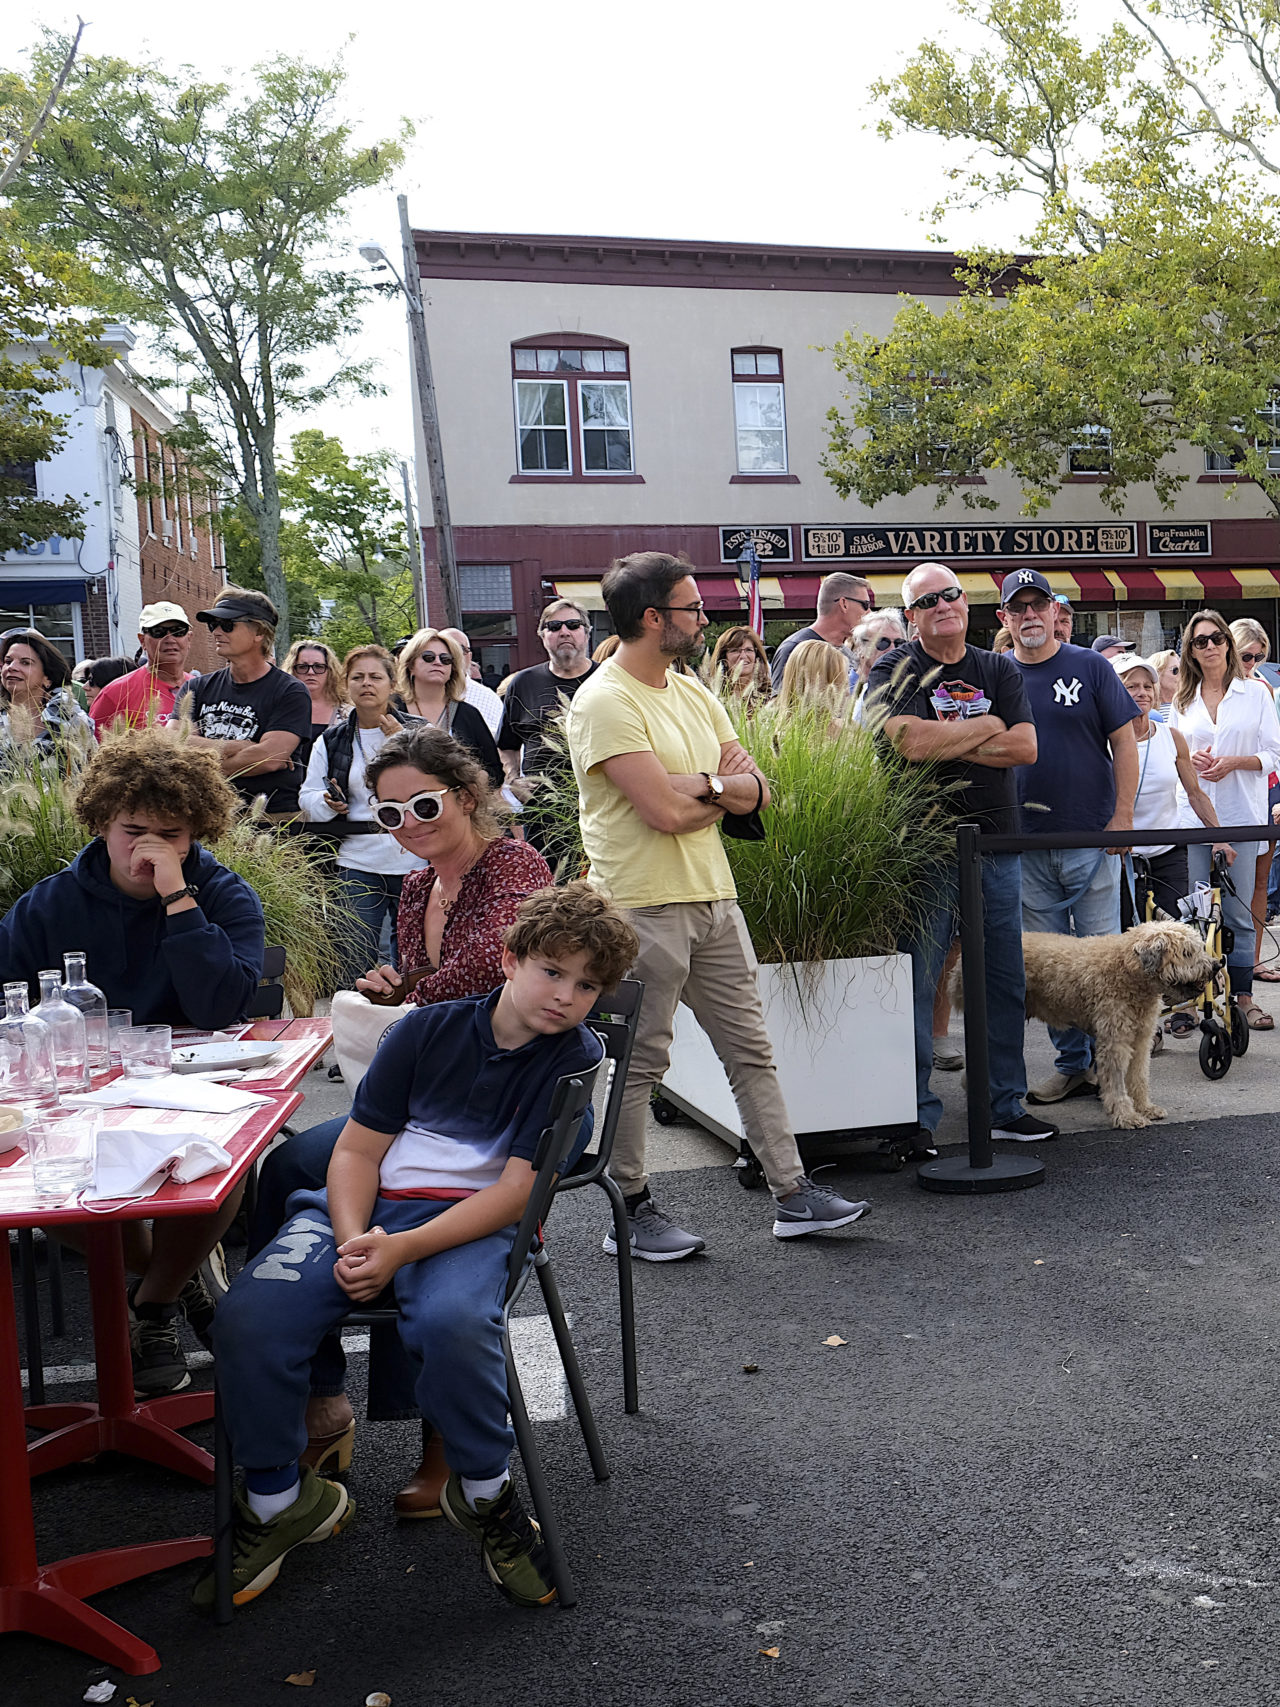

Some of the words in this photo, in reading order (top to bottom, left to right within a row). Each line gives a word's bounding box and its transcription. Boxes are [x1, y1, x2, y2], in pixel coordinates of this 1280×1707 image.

[725, 529, 787, 550] ESTALISHED
[853, 533, 876, 545] SAG
[886, 530, 1006, 554] VARIETY
[1013, 529, 1095, 552] STORE
[1115, 541, 1127, 550] UP
[1159, 537, 1200, 551] Crafts
[827, 544, 841, 554] UP
[849, 540, 886, 555] HARBOR
[1018, 571, 1034, 584] NY
[1052, 677, 1083, 706] NY
